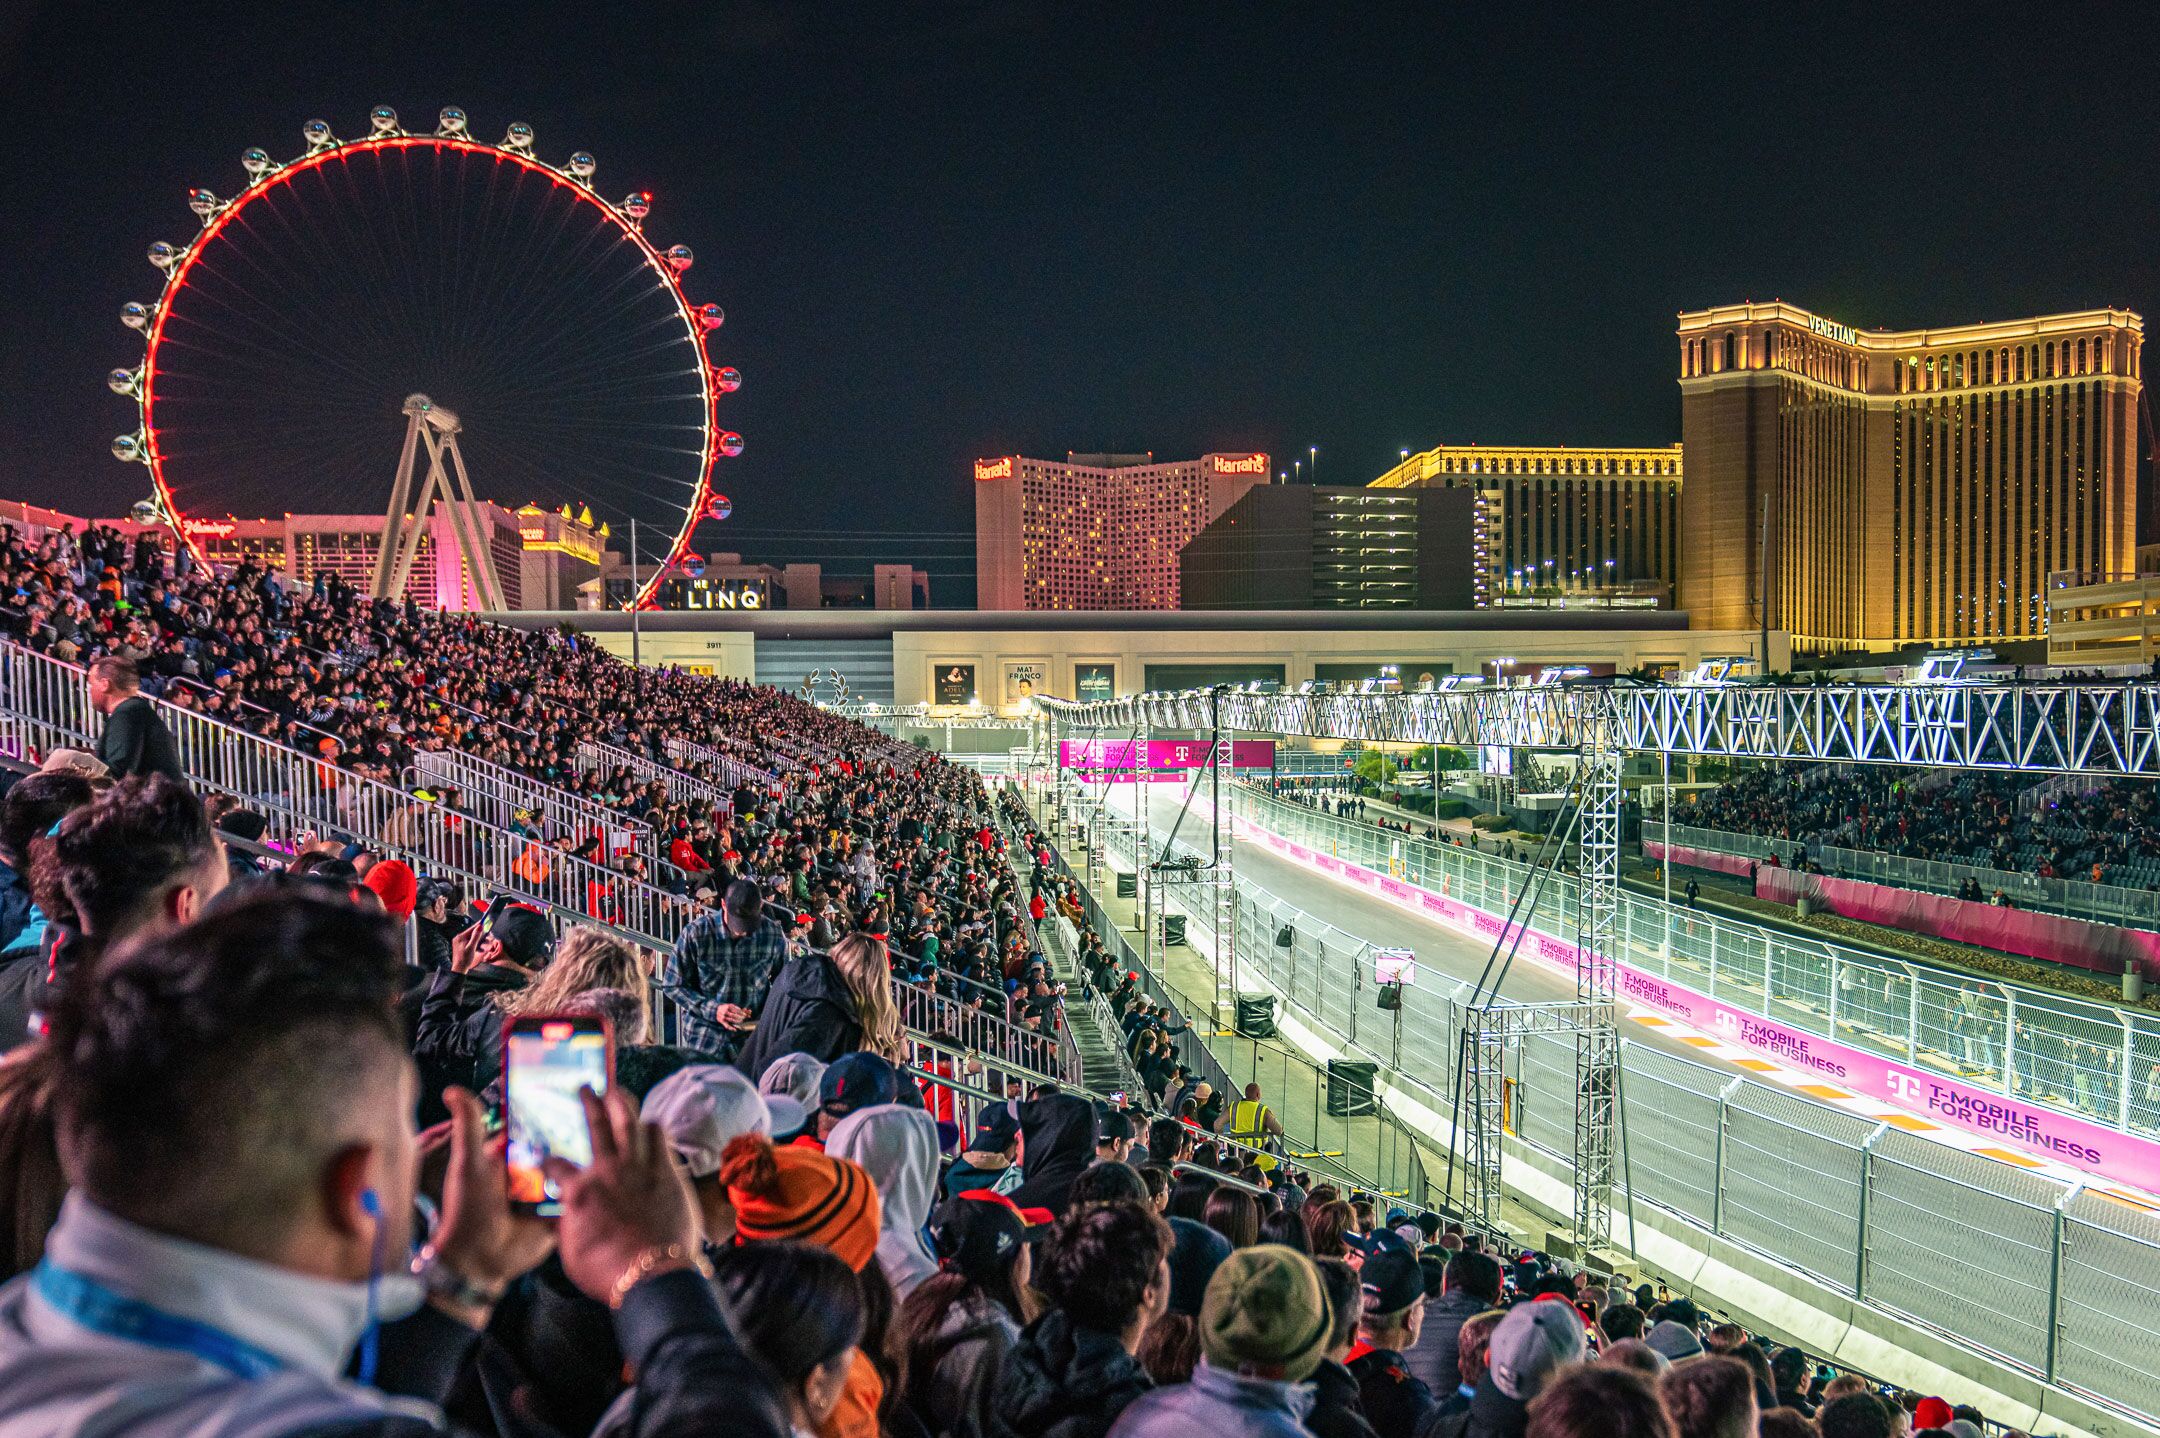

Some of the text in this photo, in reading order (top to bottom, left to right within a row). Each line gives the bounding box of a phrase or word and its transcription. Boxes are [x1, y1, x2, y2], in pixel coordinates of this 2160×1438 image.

[1808, 314, 1856, 346] VENETIAN
[687, 590, 760, 609] LINQ
[1475, 914, 1501, 931] T-MOBILE
[1540, 939, 1574, 960] T-MOBILE
[1540, 948, 1554, 960] FOR
[1624, 972, 1668, 998] T-MOBILE
[1624, 982, 1692, 1018] FOR BUSINESS
[1742, 1018, 1809, 1053] T-MOBILE
[1741, 1030, 1846, 1078] FOR BUSINESS
[1929, 1083, 2039, 1131] T-MOBILE
[1928, 1096, 2102, 1165] FOR BUSINESS
